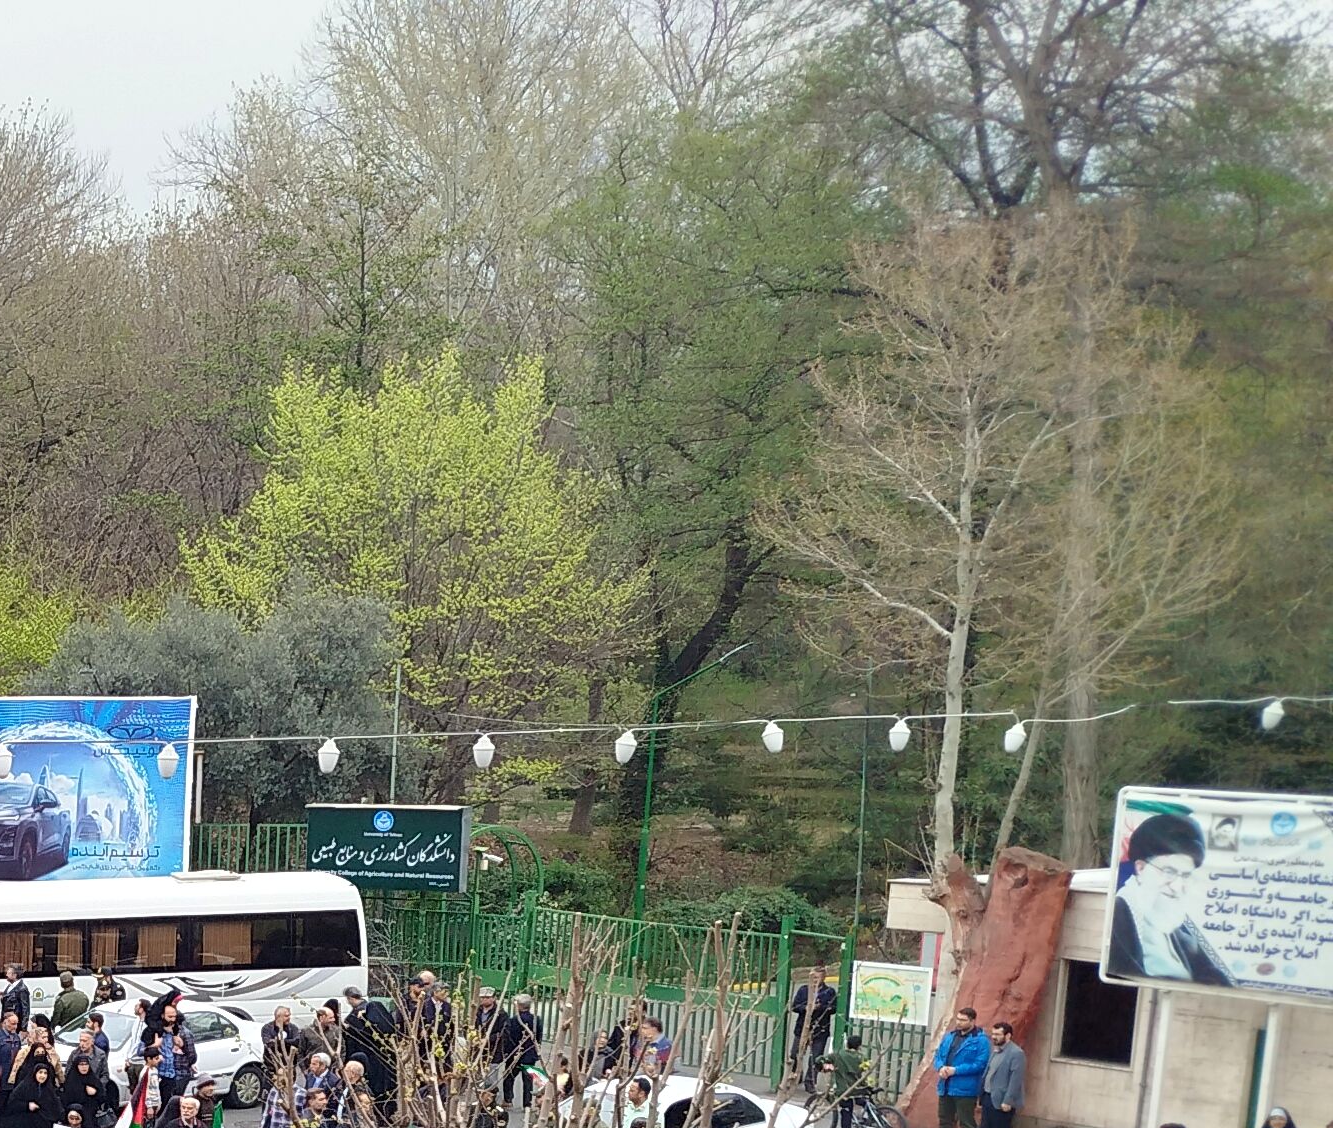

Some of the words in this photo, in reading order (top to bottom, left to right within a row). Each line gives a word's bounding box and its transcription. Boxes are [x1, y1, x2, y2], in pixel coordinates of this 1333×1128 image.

[71, 842, 110, 861] آینده
[109, 845, 161, 862] ترسیم
[311, 837, 337, 864] طبیعی
[335, 845, 358, 866] منابع
[358, 848, 364, 860] و
[364, 832, 422, 866] کشاورزی
[407, 833, 455, 867] دانشکدگان
[338, 869, 357, 878] College
[364, 870, 394, 879] Agriculture
[405, 871, 425, 879] Natural
[1209, 868, 1259, 881] اساسی
[1206, 887, 1266, 900] کشوری
[1266, 893, 1273, 904] و
[1274, 891, 1328, 907] جامعه
[1204, 901, 1238, 916] اصلاح
[1241, 904, 1287, 919] دانشگاه
[1290, 909, 1310, 925] اگر
[1202, 920, 1235, 936] جامعه
[1238, 919, 1256, 938] آن
[1243, 942, 1281, 959] خواهد
[1282, 945, 1319, 961] اصلاح
